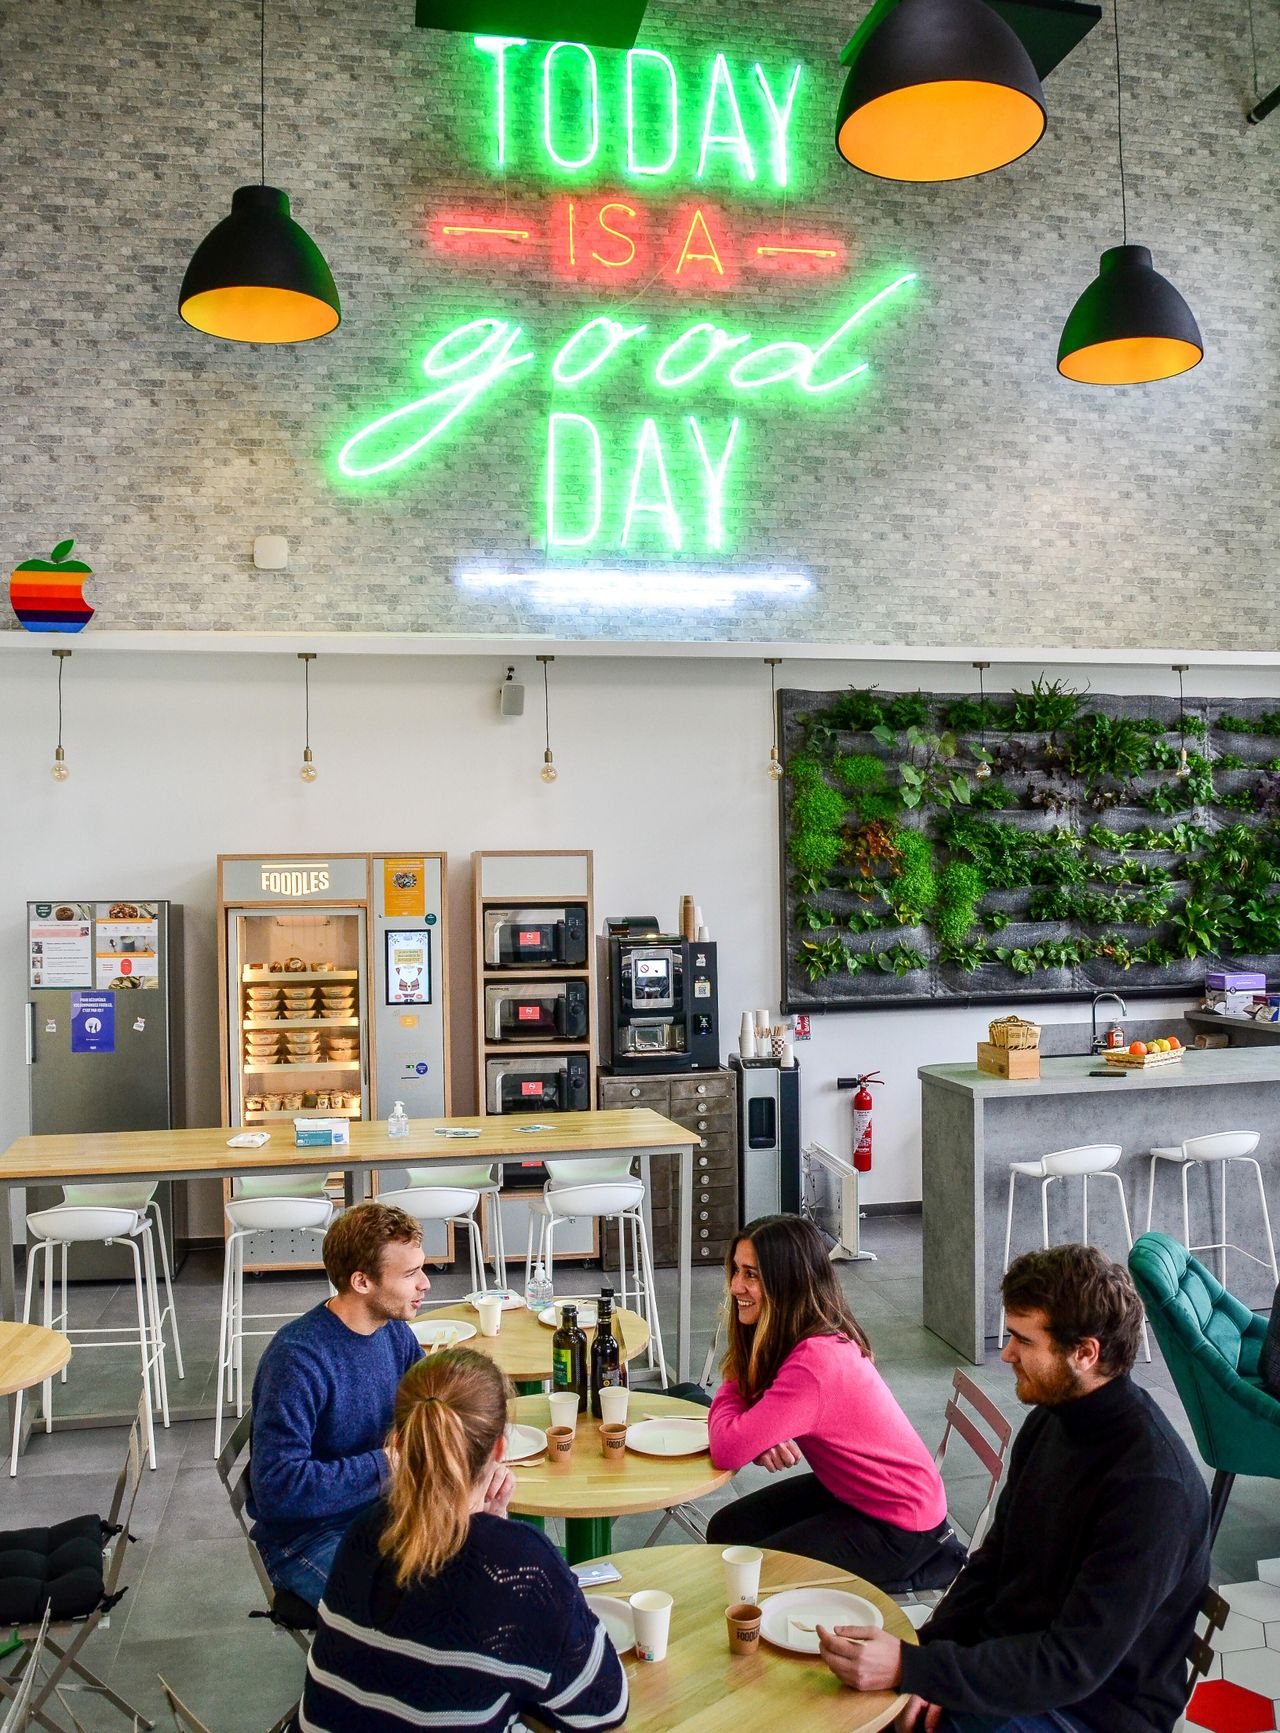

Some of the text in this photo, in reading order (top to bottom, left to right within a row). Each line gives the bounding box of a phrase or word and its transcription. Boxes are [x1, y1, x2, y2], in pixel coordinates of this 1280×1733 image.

[474, 35, 801, 188] TODAY
[568, 203, 724, 275] IS A
[337, 273, 917, 477] good
[546, 413, 739, 551] DAY
[261, 871, 329, 896] FOODLES
